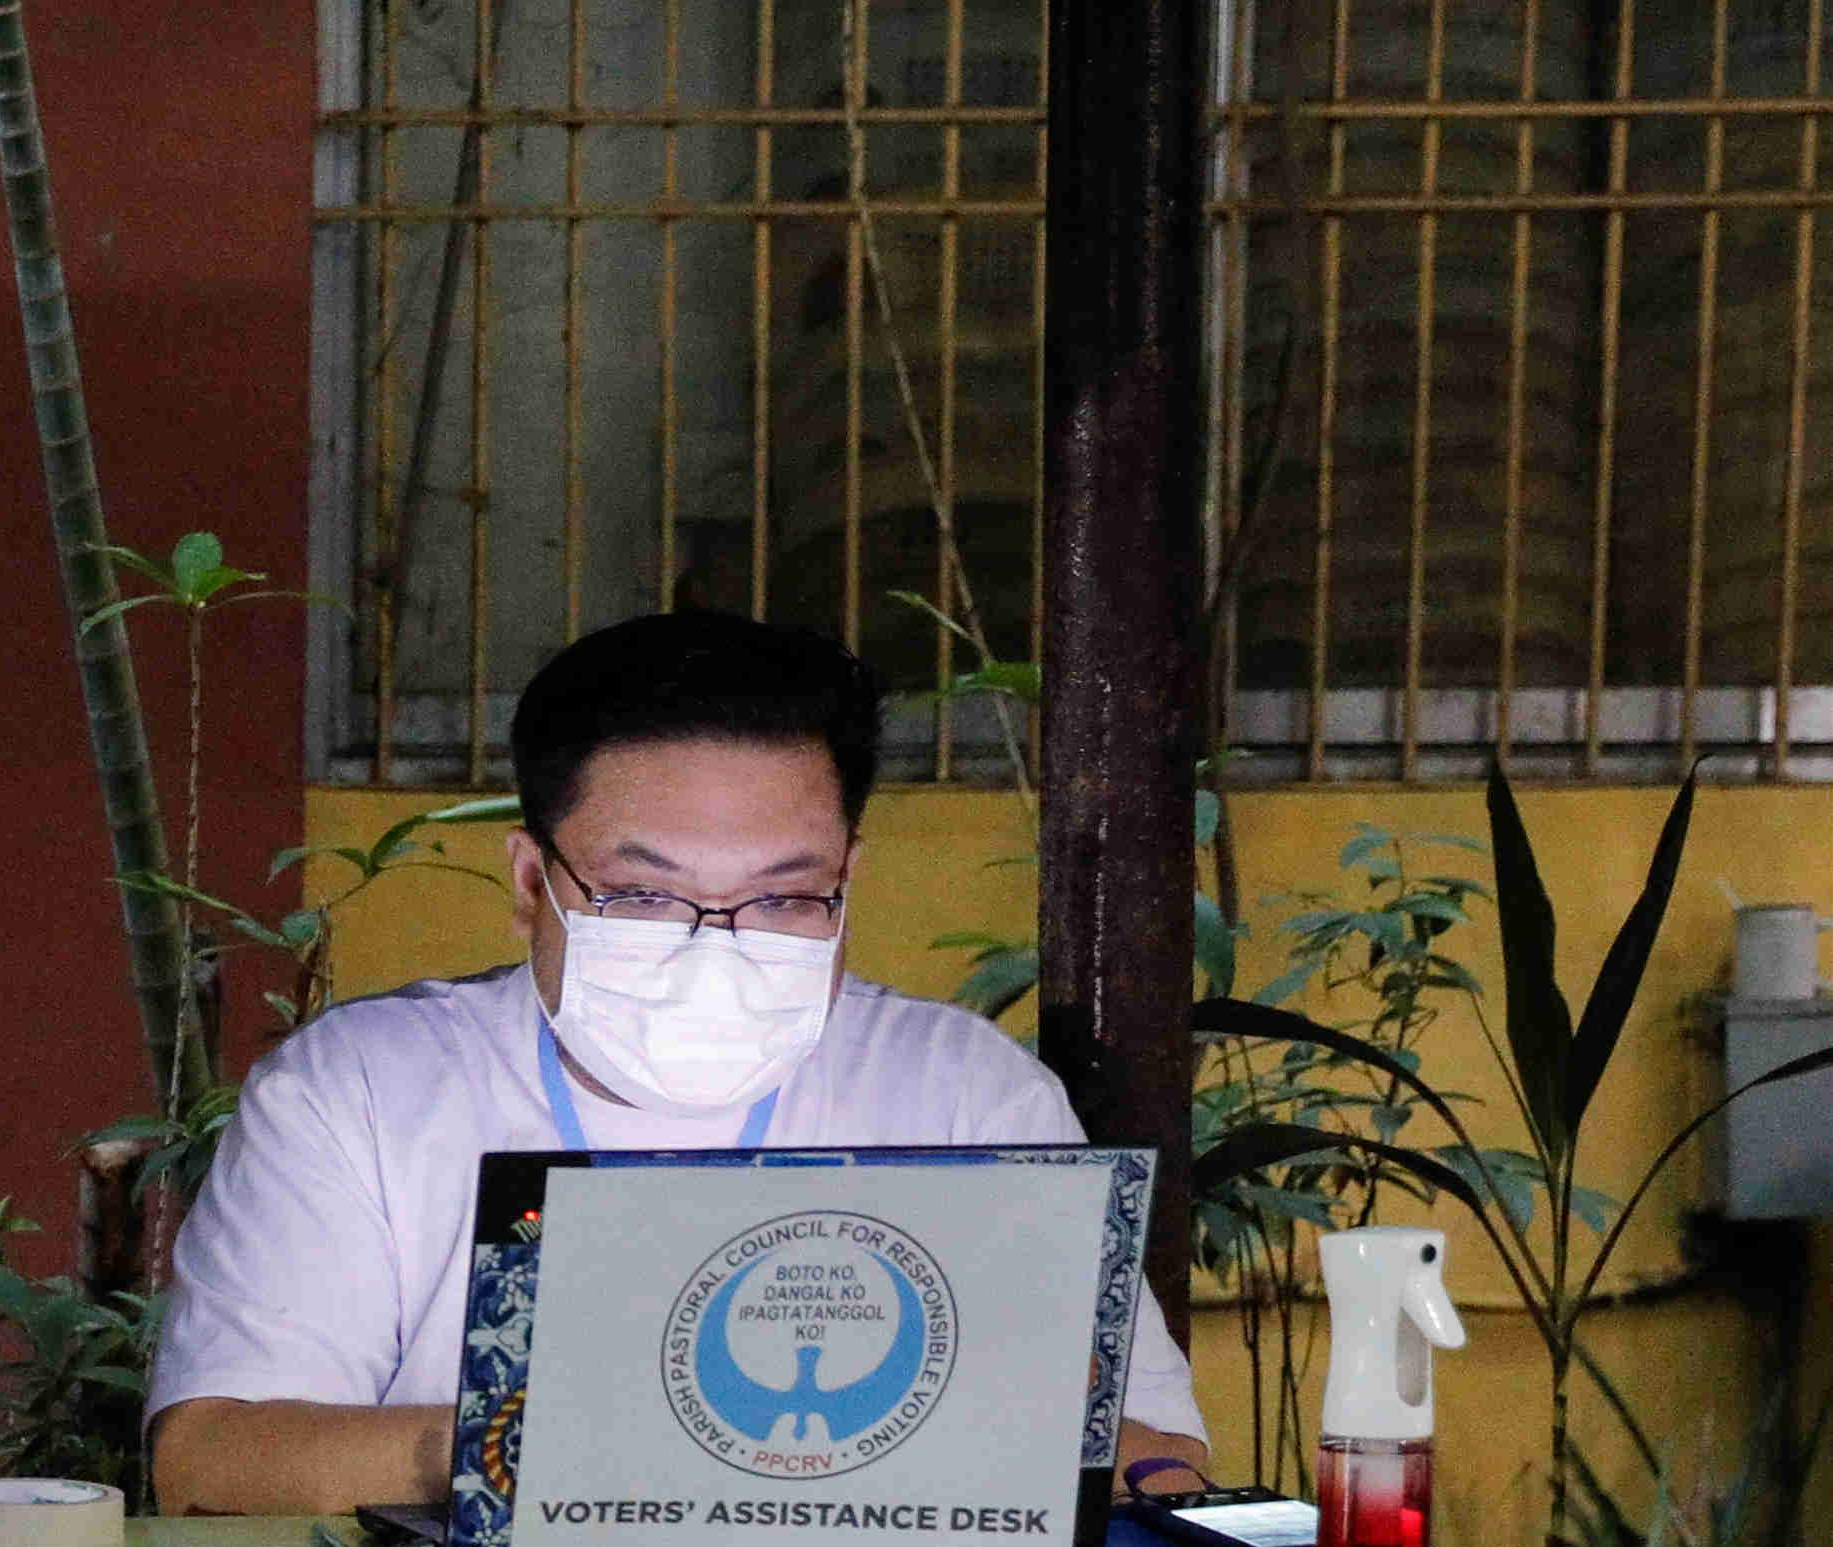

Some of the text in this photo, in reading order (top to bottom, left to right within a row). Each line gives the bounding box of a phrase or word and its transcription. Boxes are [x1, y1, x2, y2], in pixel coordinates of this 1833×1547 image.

[775, 1265, 824, 1281] BOTO
[764, 1285, 865, 1301] DANGAL KO
[739, 1304, 886, 1321] IPAGTATANGGOL
[670, 1220, 948, 1456] PARISH PASTORAL COUNCIL FOR RESPONSIBLE VOTING
[795, 1325, 826, 1341] KO!
[752, 1450, 834, 1472] PPCRV
[540, 1500, 1049, 1535] VOTERS’ ASSISTANCE DESK
